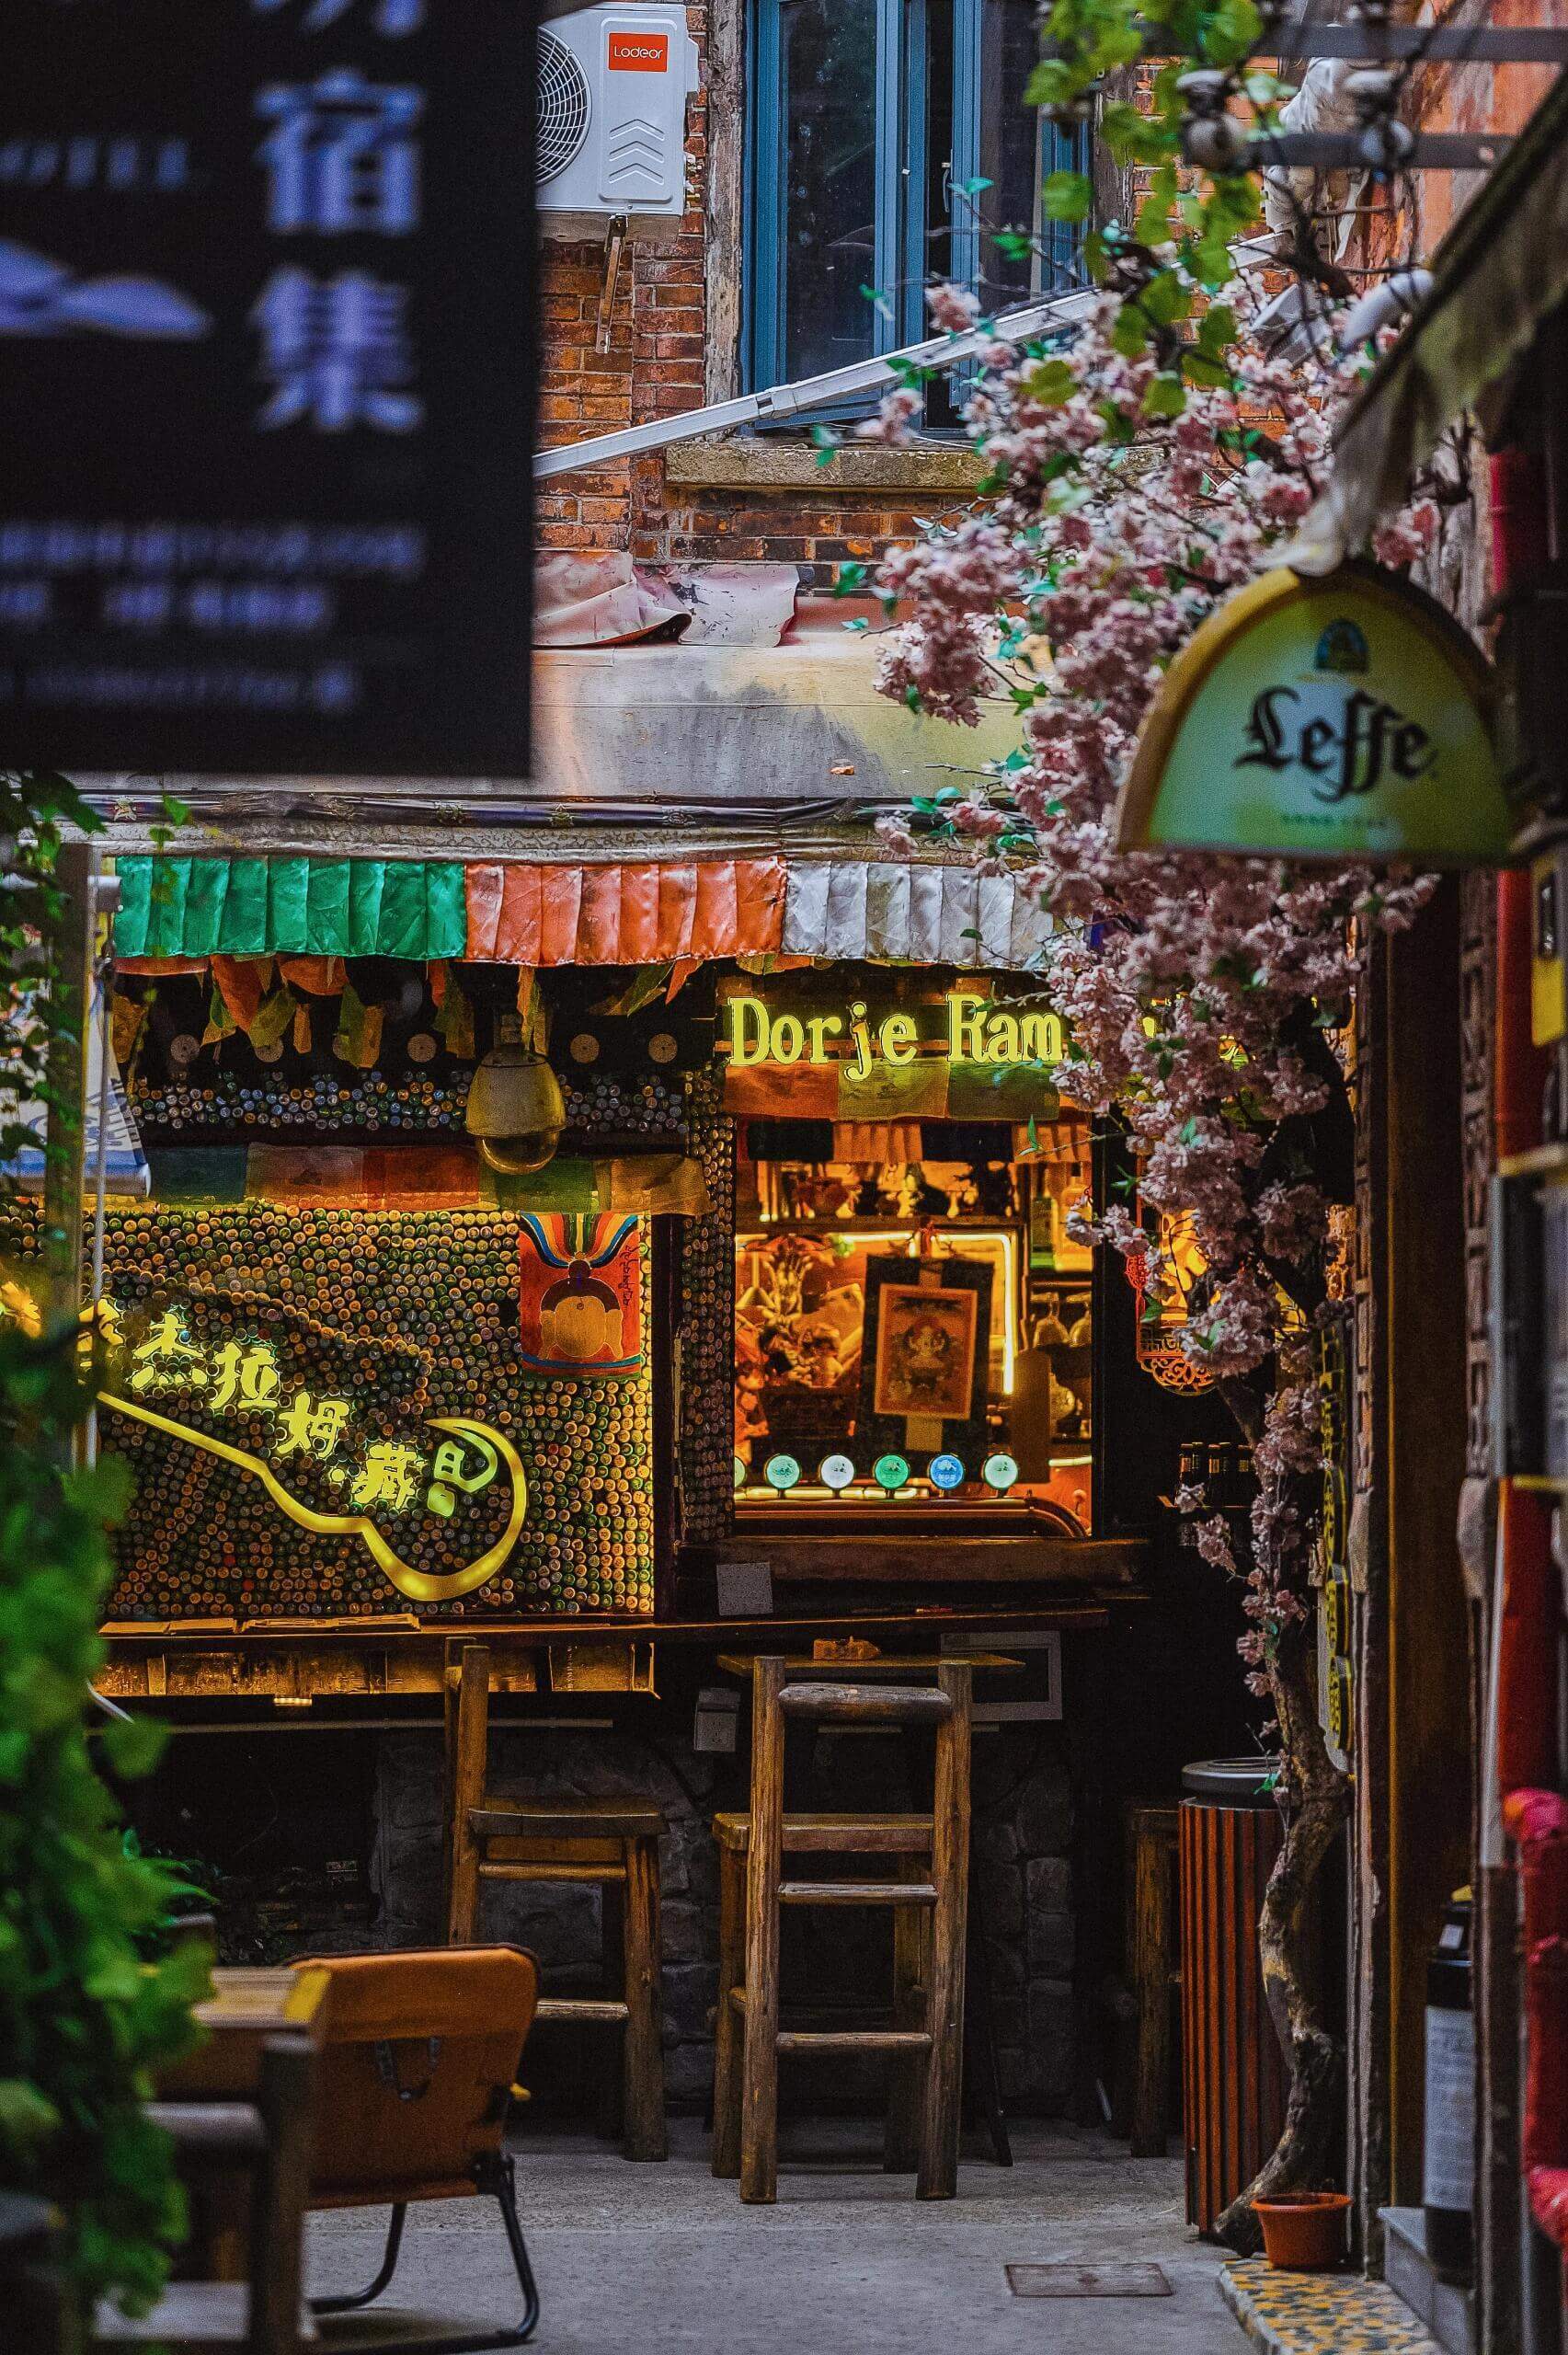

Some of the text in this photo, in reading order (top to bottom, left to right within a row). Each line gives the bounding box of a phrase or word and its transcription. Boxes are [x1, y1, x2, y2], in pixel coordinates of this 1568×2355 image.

[250, 0, 424, 432] 宿集
[1233, 684, 1439, 804] Leffe
[727, 995, 919, 1083] Dorje
